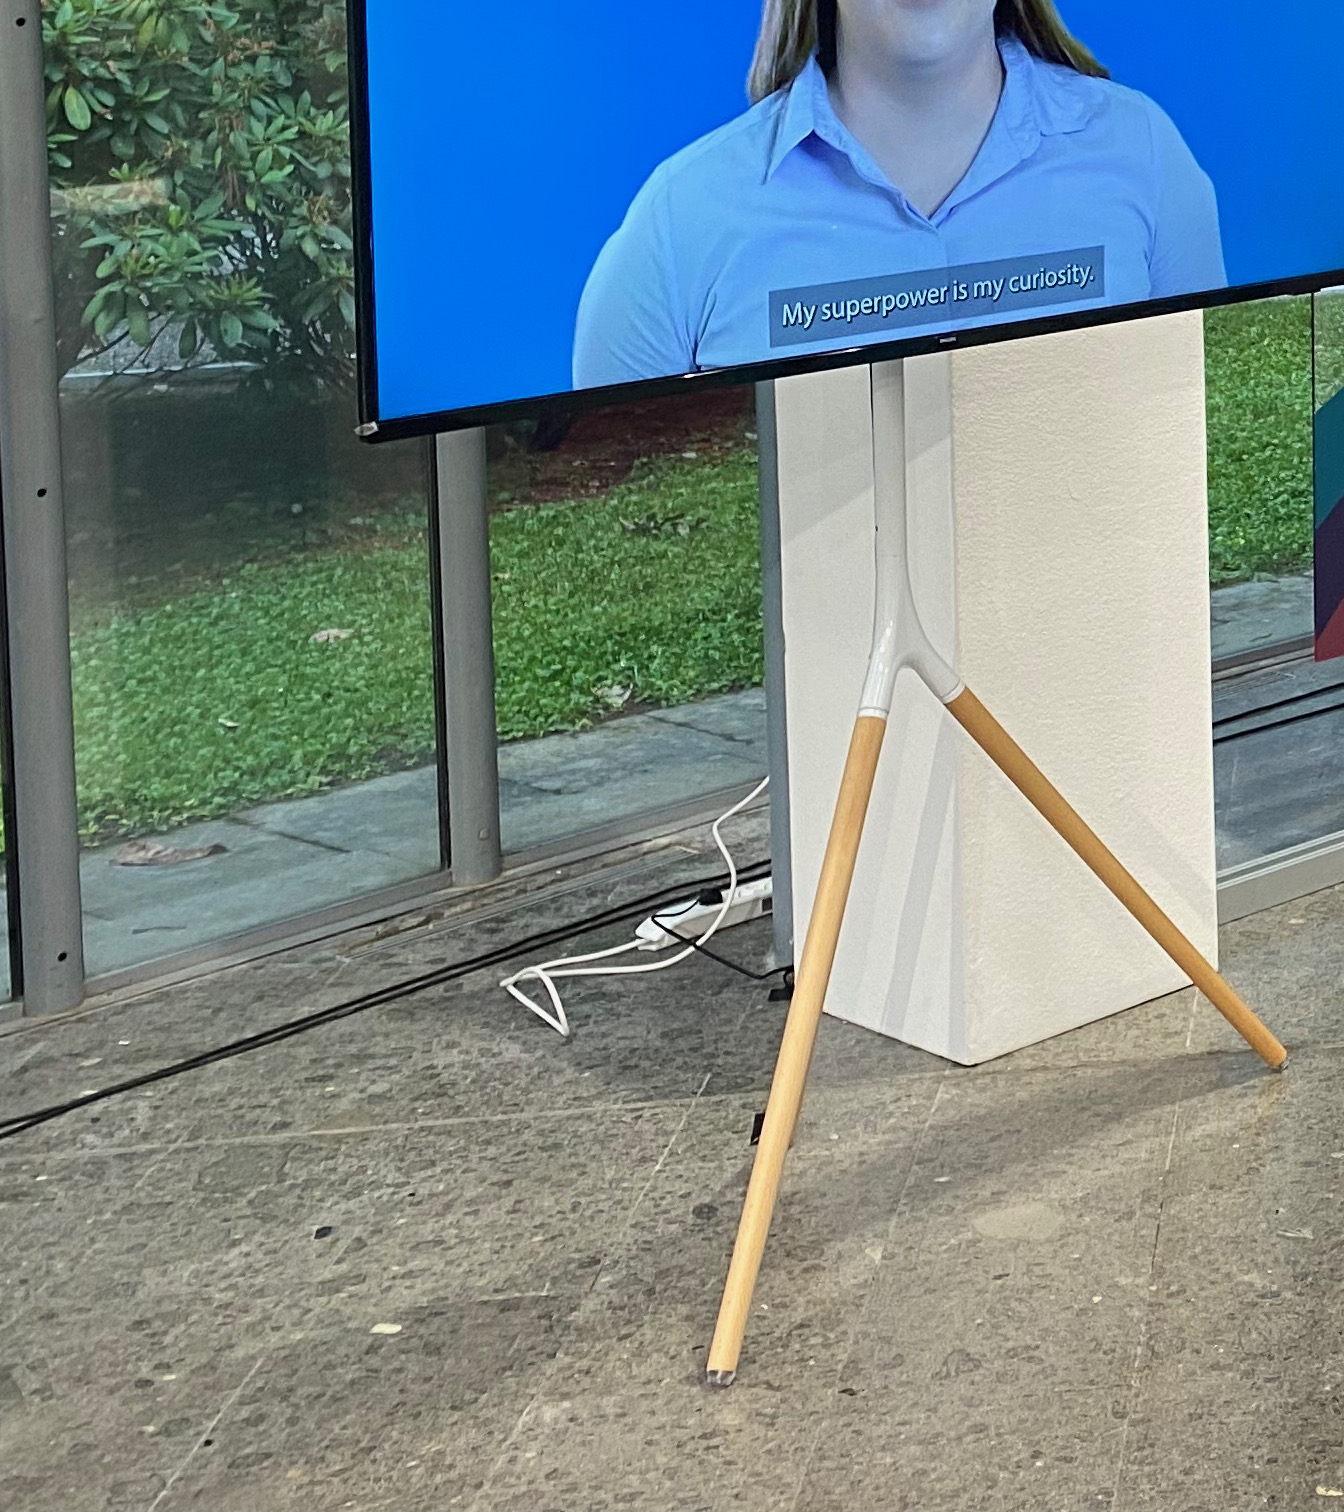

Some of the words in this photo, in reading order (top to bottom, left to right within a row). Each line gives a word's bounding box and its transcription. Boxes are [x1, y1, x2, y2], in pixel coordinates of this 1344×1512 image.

[781, 301, 817, 329] My
[821, 285, 948, 322] superpower
[952, 279, 968, 300] is
[973, 276, 1005, 304] my
[1009, 262, 1095, 293] curiosity.
